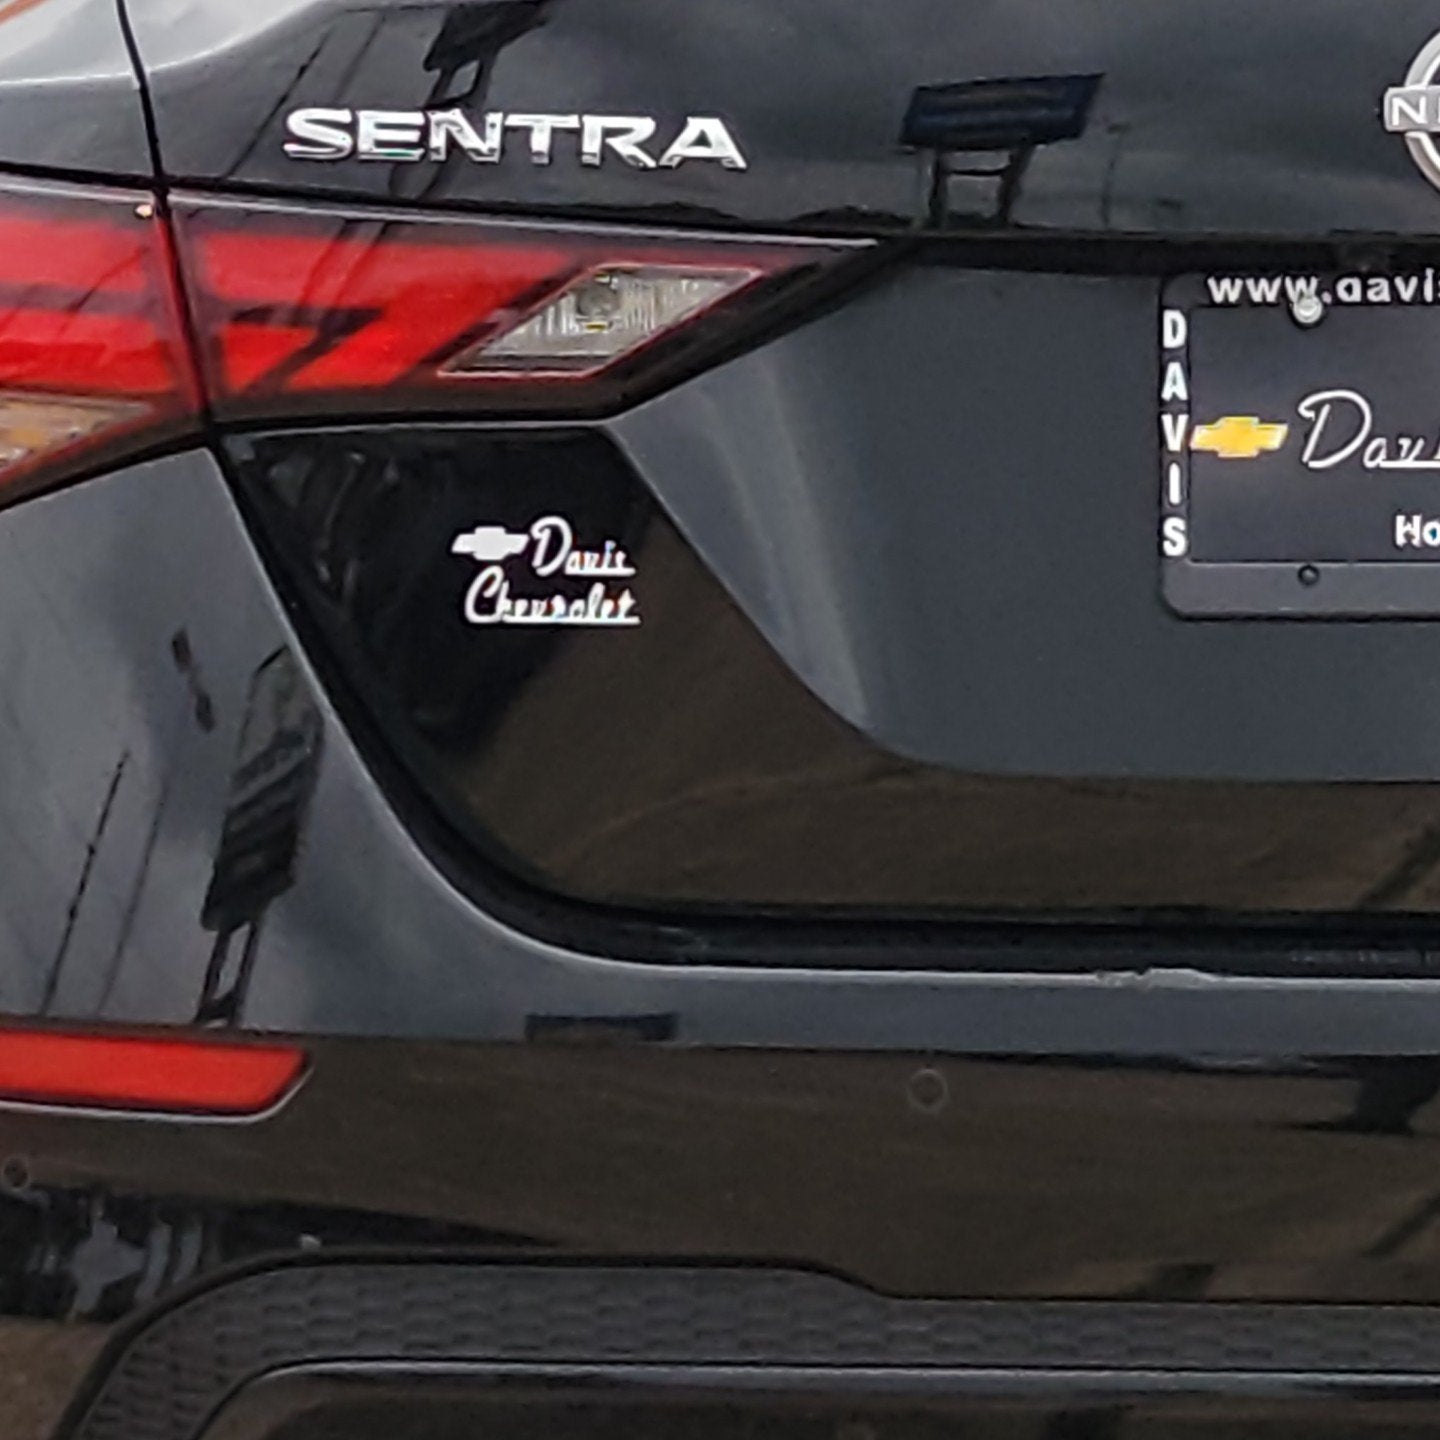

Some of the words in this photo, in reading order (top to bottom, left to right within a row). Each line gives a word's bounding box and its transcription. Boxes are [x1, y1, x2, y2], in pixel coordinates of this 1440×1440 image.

[282, 108, 748, 171] SENTRA
[1162, 310, 1188, 557] DAVIS
[529, 515, 637, 578] Davis
[463, 564, 643, 626] Chevrolet
